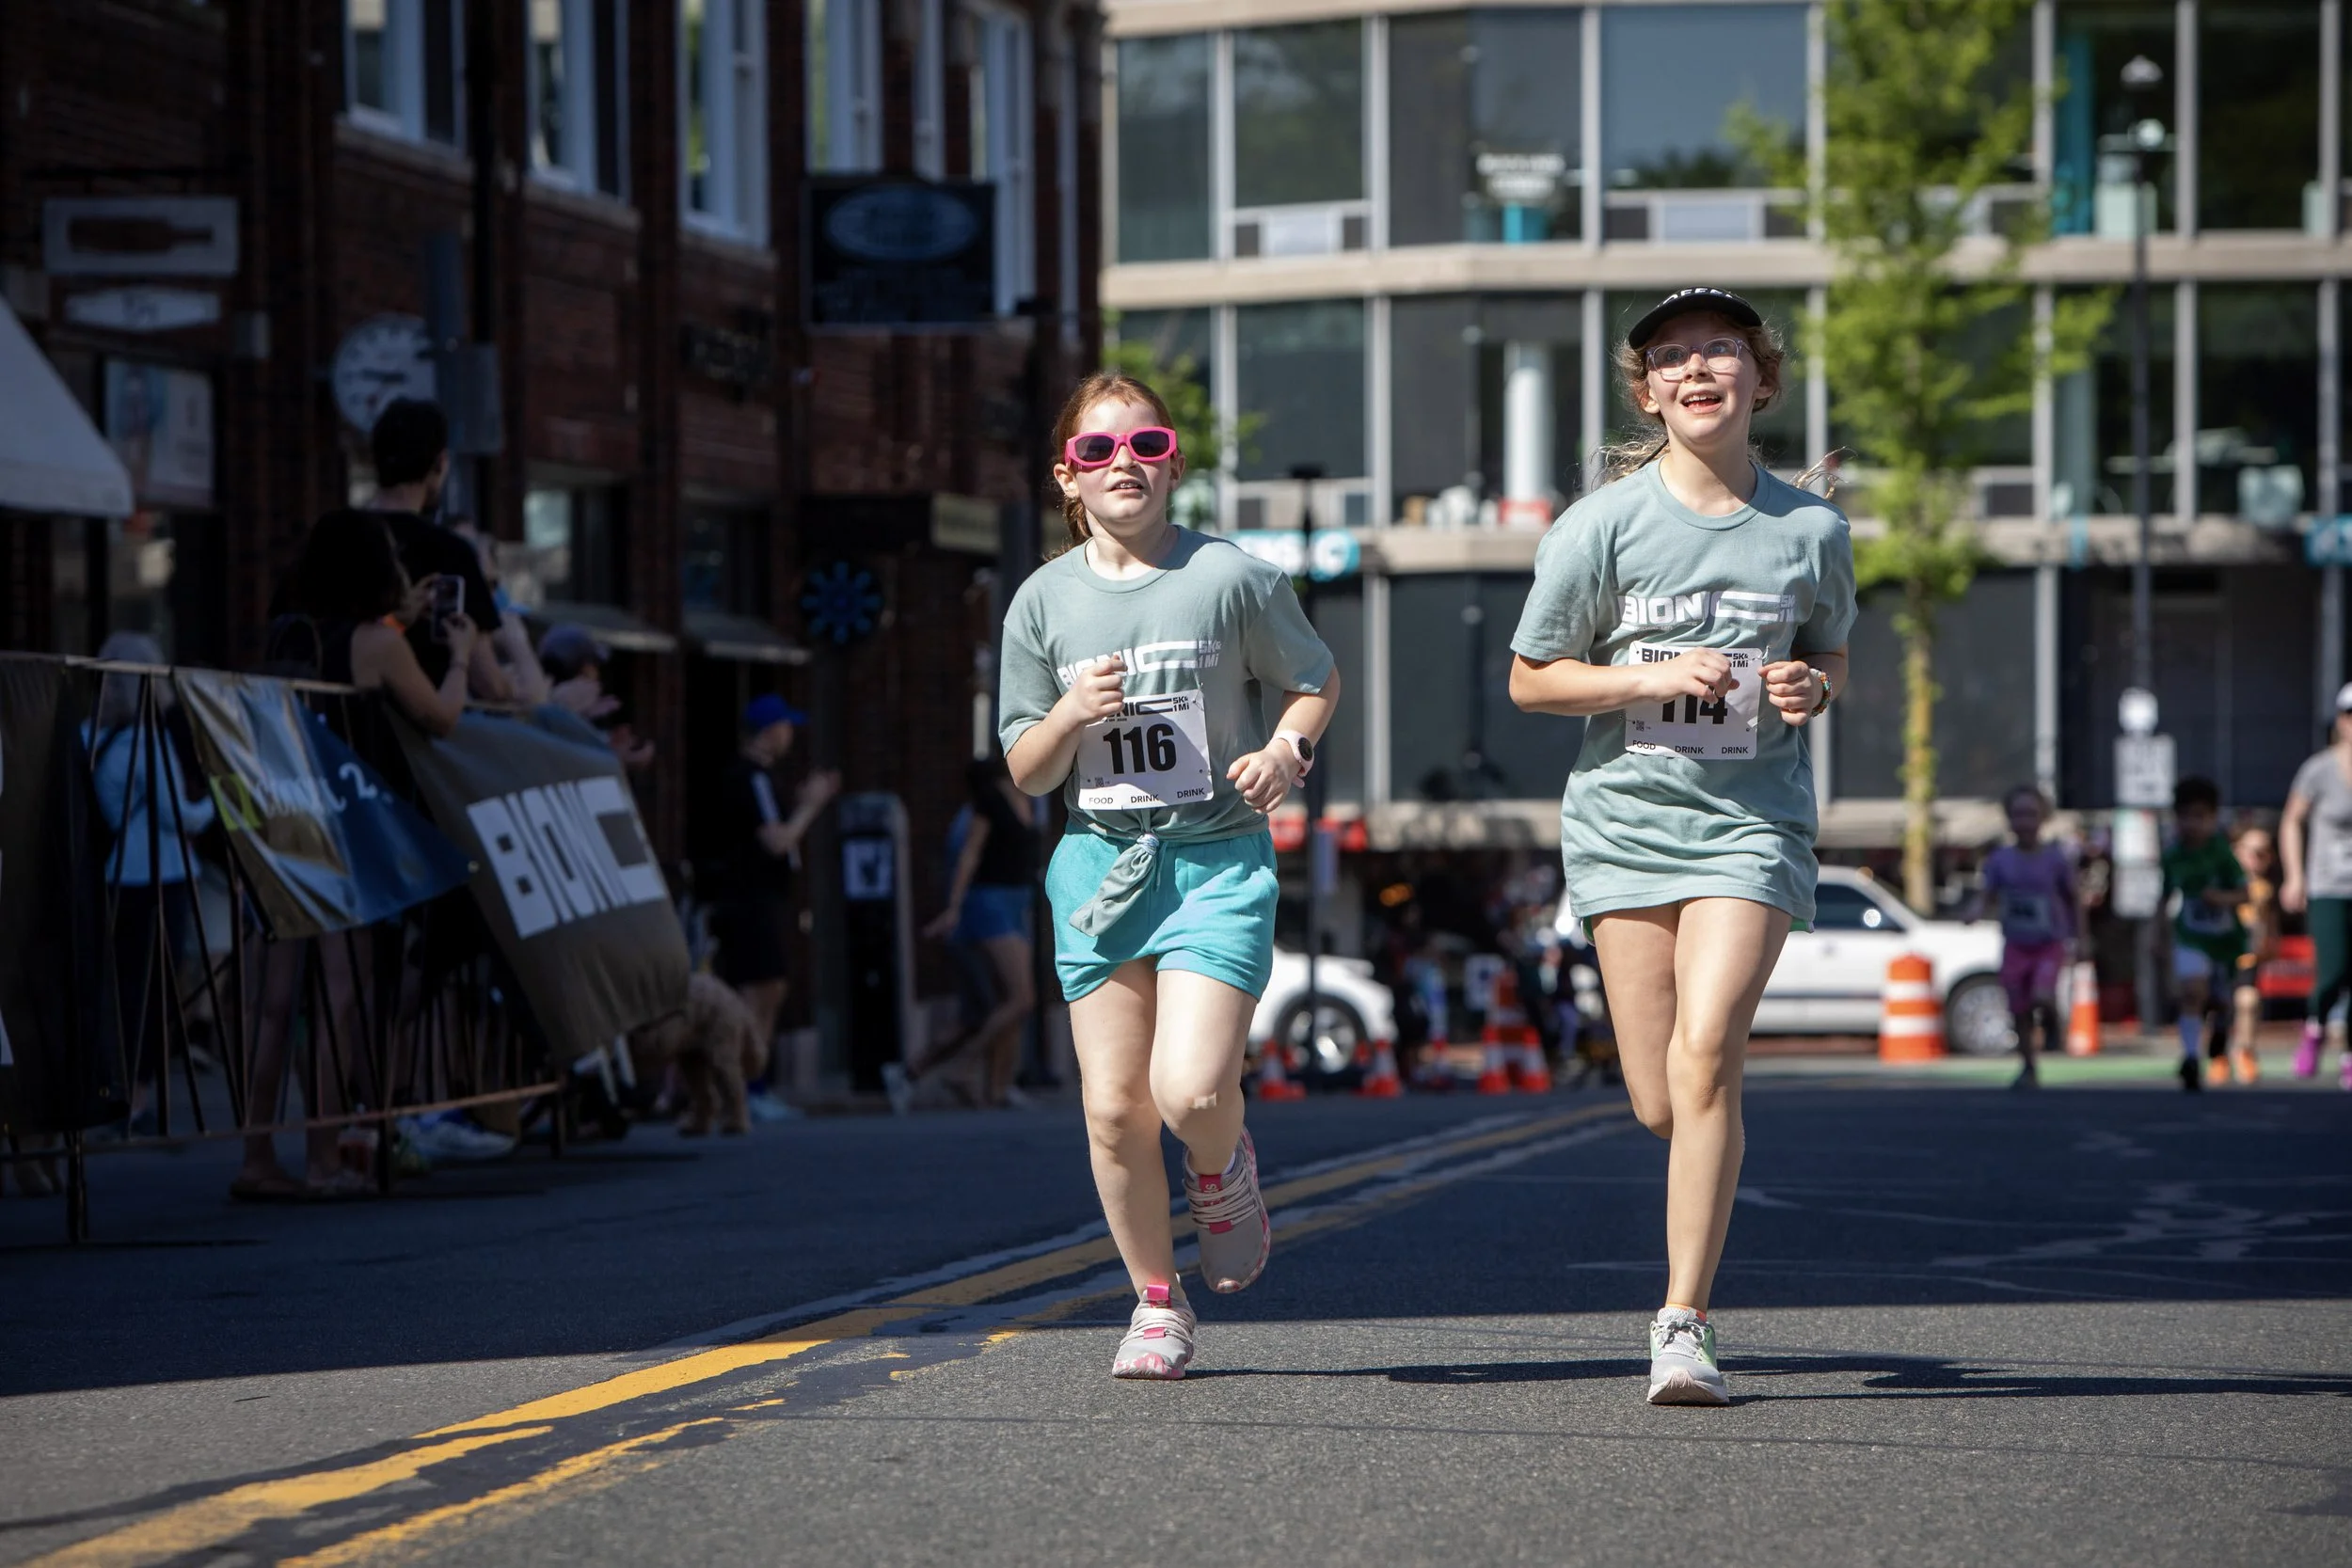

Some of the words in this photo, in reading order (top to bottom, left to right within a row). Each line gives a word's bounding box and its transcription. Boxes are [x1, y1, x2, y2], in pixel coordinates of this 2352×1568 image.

[1057, 641, 1197, 688] BIIC
[1103, 723, 1177, 774] 116
[1632, 739, 1656, 751] FOOD
[1675, 745, 1704, 754] DRINK
[1721, 746, 1749, 754] DRINK
[1130, 794, 1159, 803] DRINK
[1177, 787, 1204, 799] DRINK
